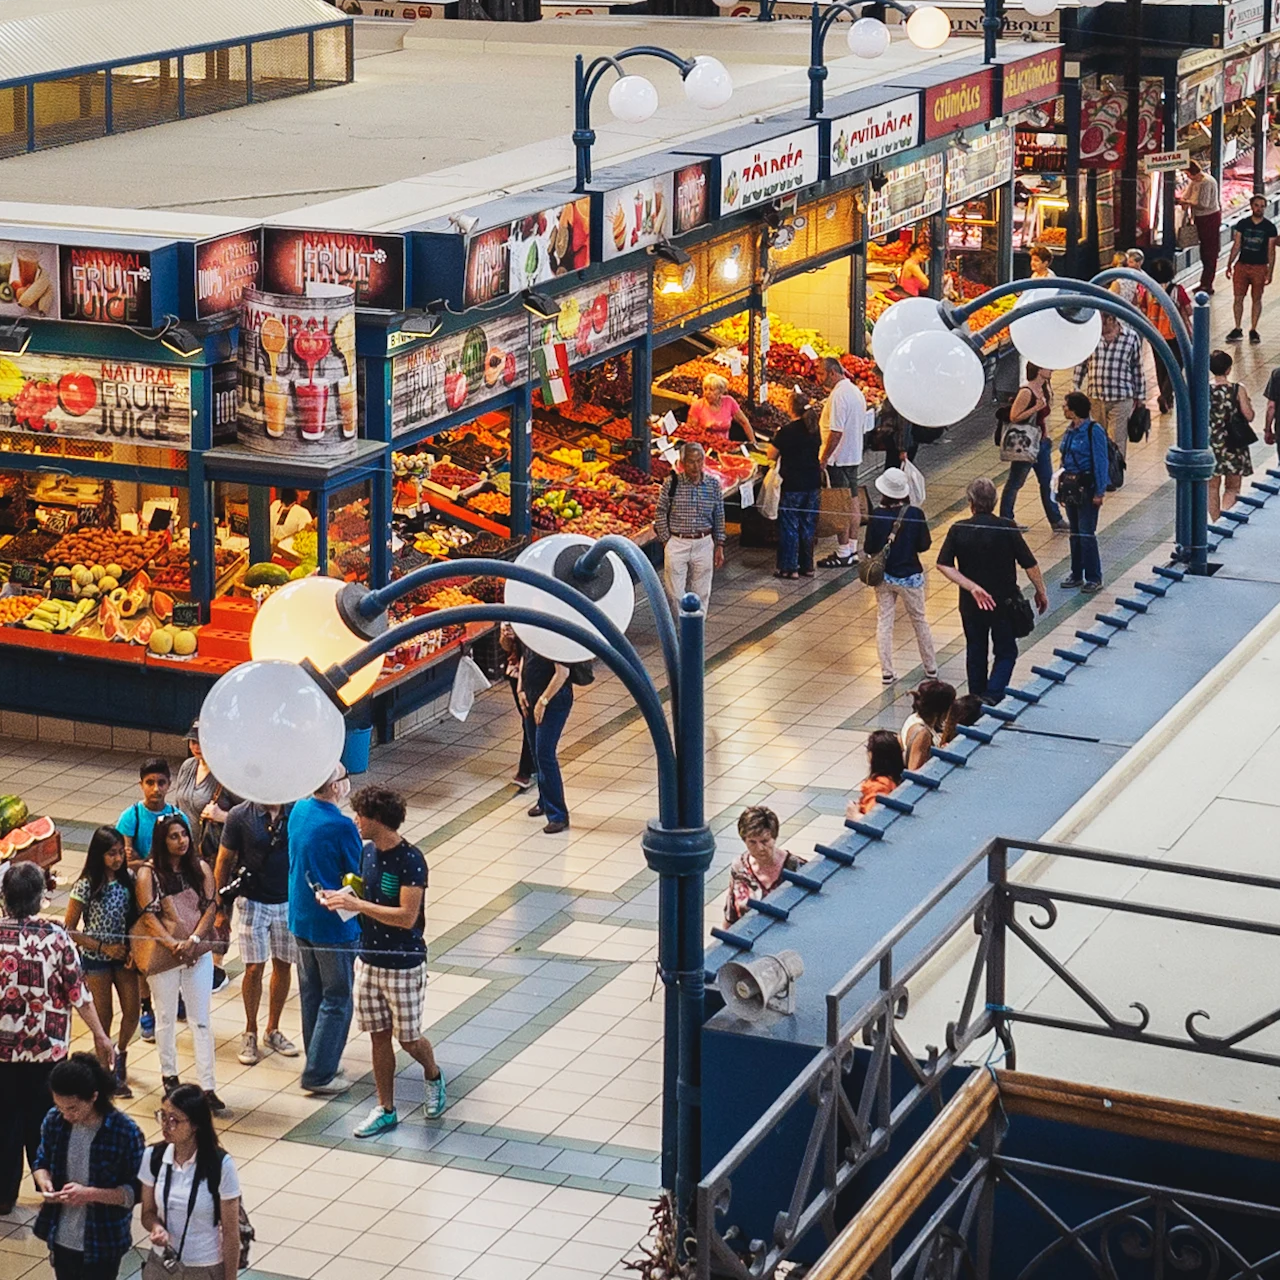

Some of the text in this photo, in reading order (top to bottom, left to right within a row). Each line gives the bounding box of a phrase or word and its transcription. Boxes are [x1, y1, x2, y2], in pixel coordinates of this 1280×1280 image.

[934, 83, 981, 123] GYÜMÖLCS
[303, 233, 376, 253] NATURAL
[71, 249, 142, 270] NATURAL
[303, 249, 374, 277] FRUIT
[72, 265, 141, 294] FRUIT
[68, 293, 138, 322] JUICE
[100, 363, 174, 387] NATURAL
[101, 381, 174, 414] FRUIT
[95, 408, 171, 441] JUICE
